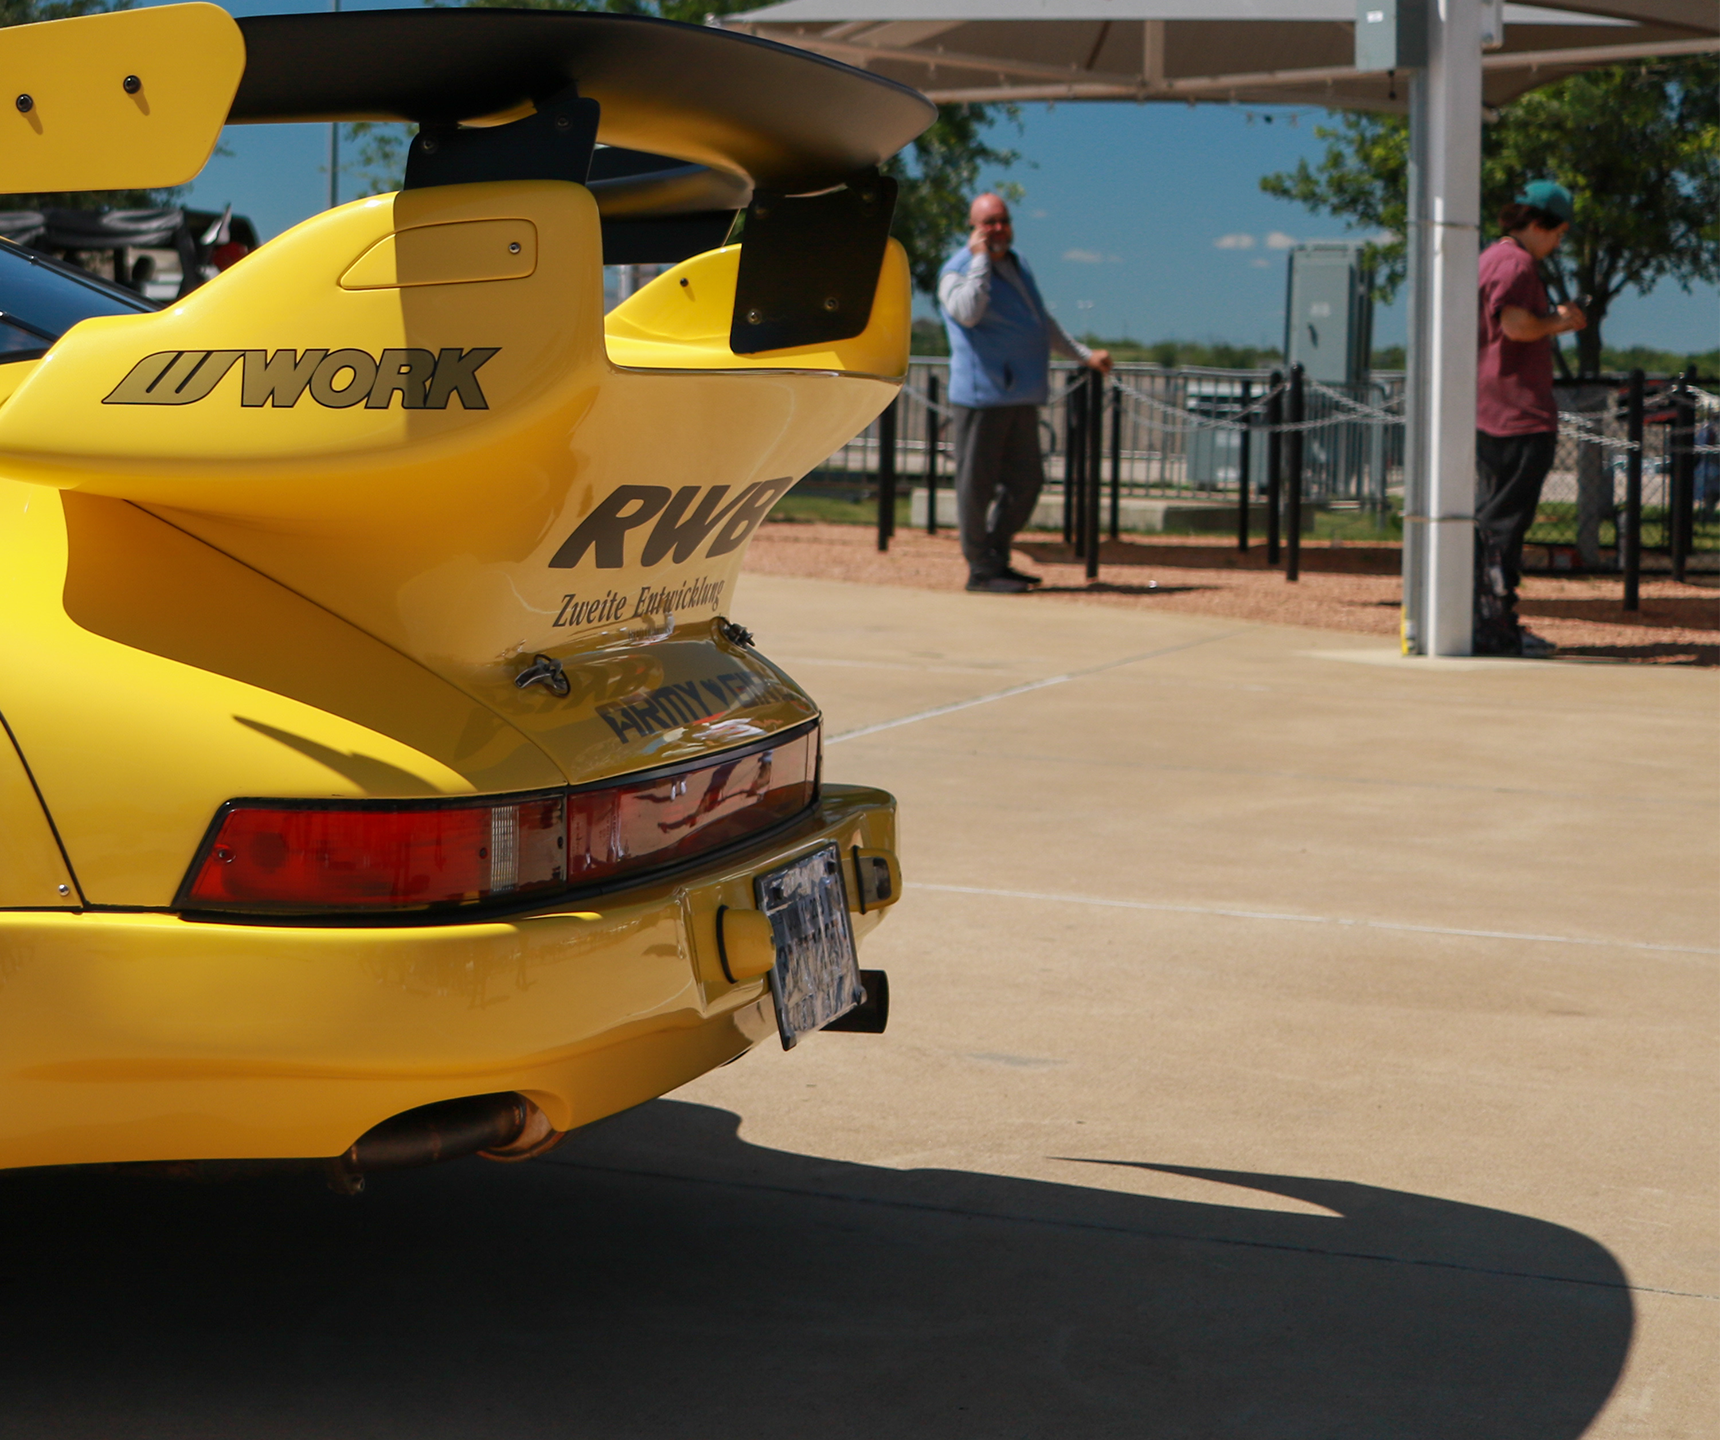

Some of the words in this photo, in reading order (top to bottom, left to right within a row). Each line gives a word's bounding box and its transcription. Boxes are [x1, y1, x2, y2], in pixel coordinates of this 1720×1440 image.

[240, 346, 502, 410] WORK
[548, 476, 794, 569] RWB
[552, 589, 627, 628] Zweite
[632, 575, 726, 618] Entwicklung
[595, 679, 714, 745] ARMY
